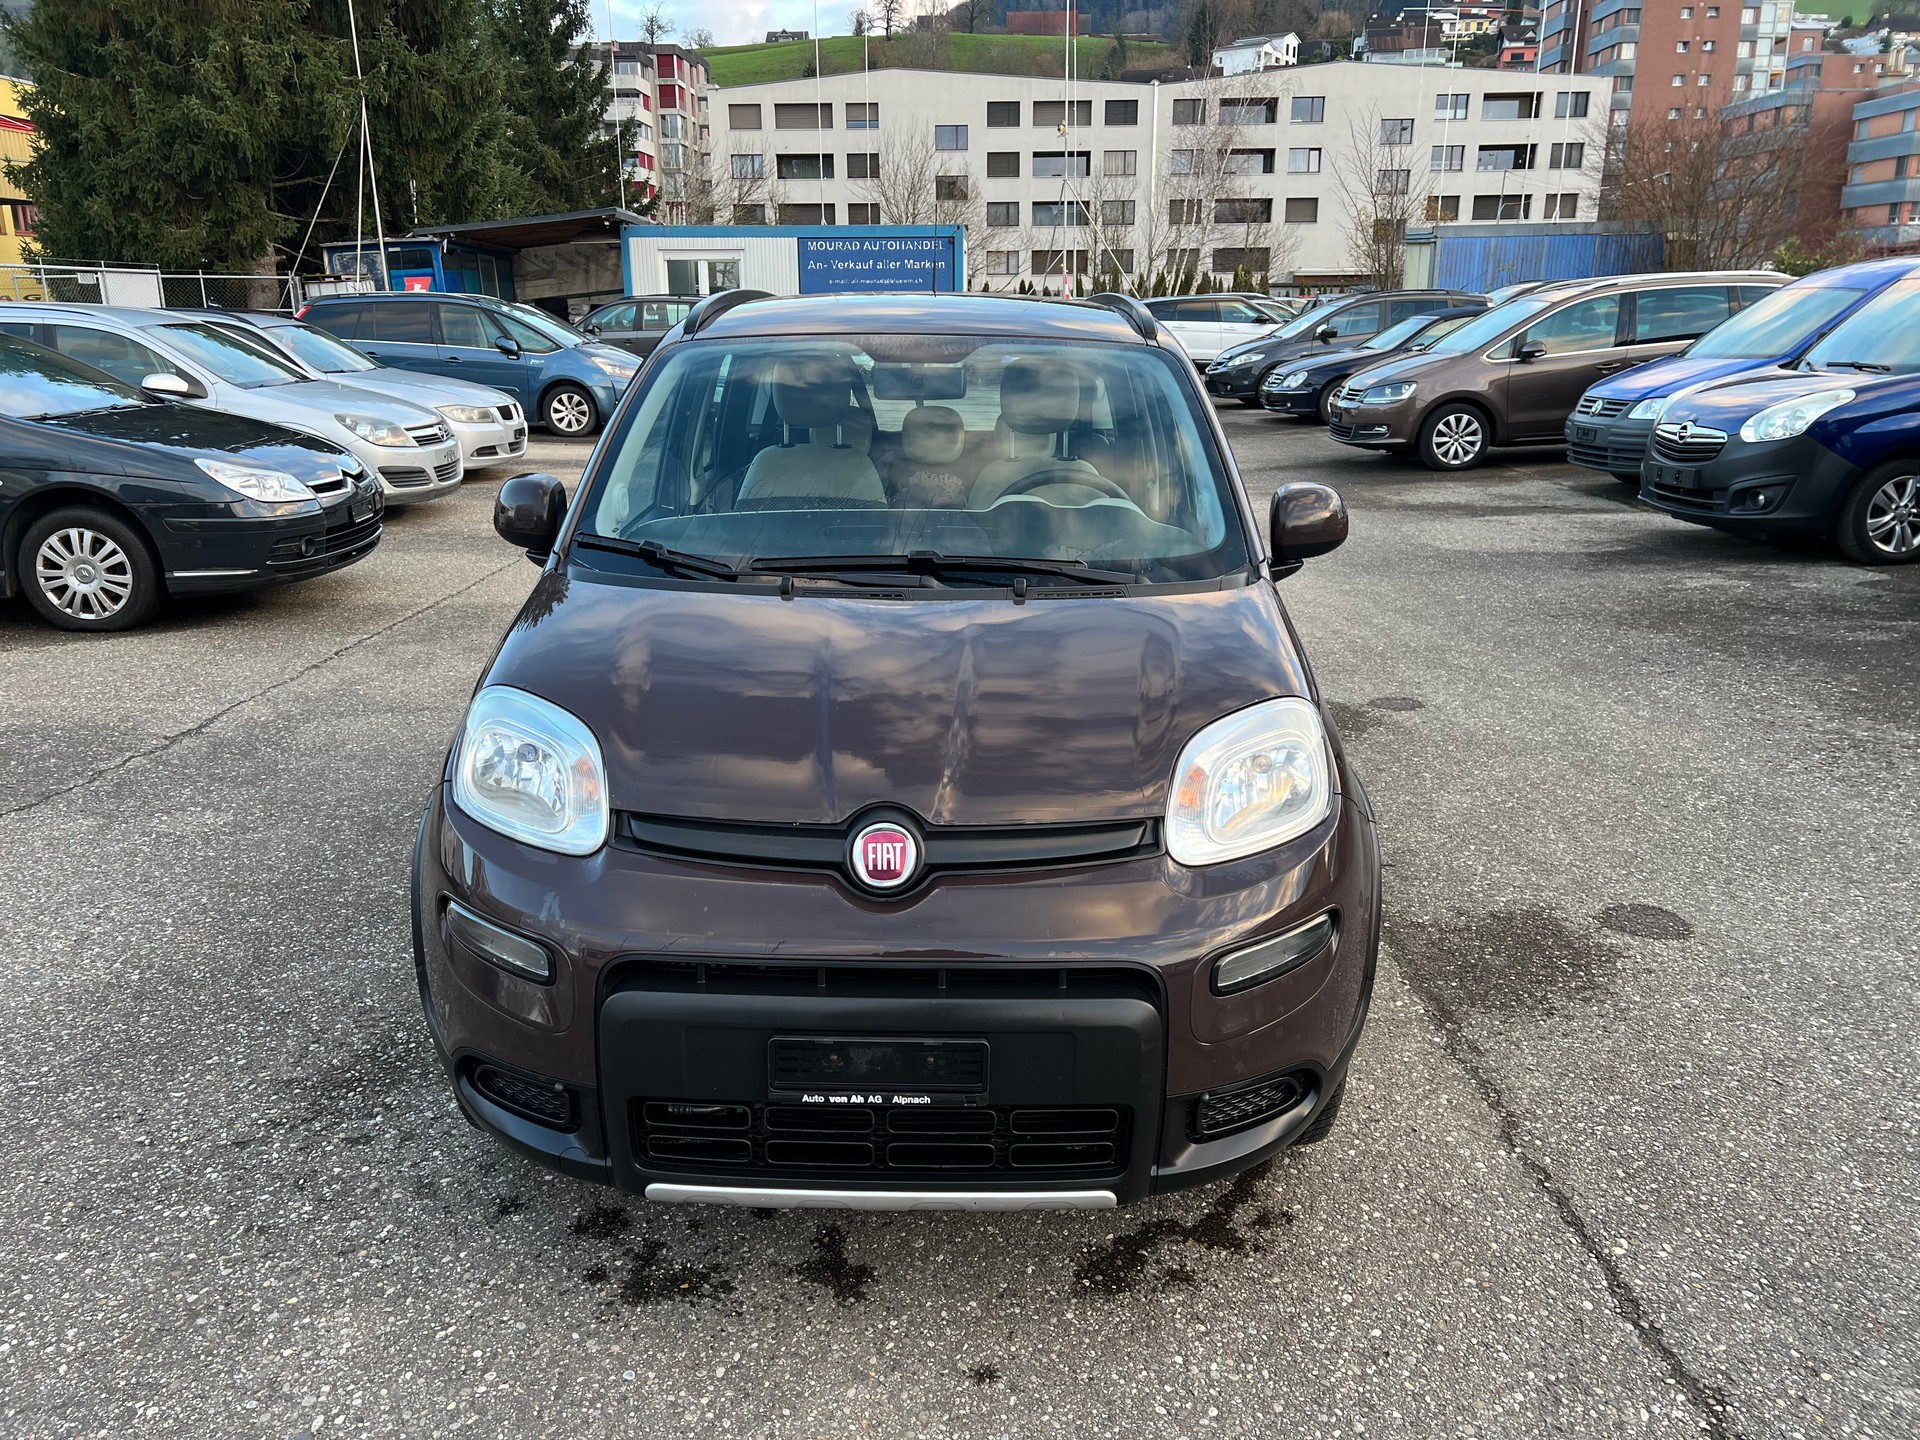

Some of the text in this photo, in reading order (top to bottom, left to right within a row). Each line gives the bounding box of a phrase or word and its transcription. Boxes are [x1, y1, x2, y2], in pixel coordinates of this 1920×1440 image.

[807, 240, 946, 251] MOURAD AUTOHANDEL
[807, 259, 945, 270] An- Verkauf aller Marken
[867, 842, 904, 871] FIAT
[802, 1094, 931, 1105] Auto von Ah AG Alpnach
